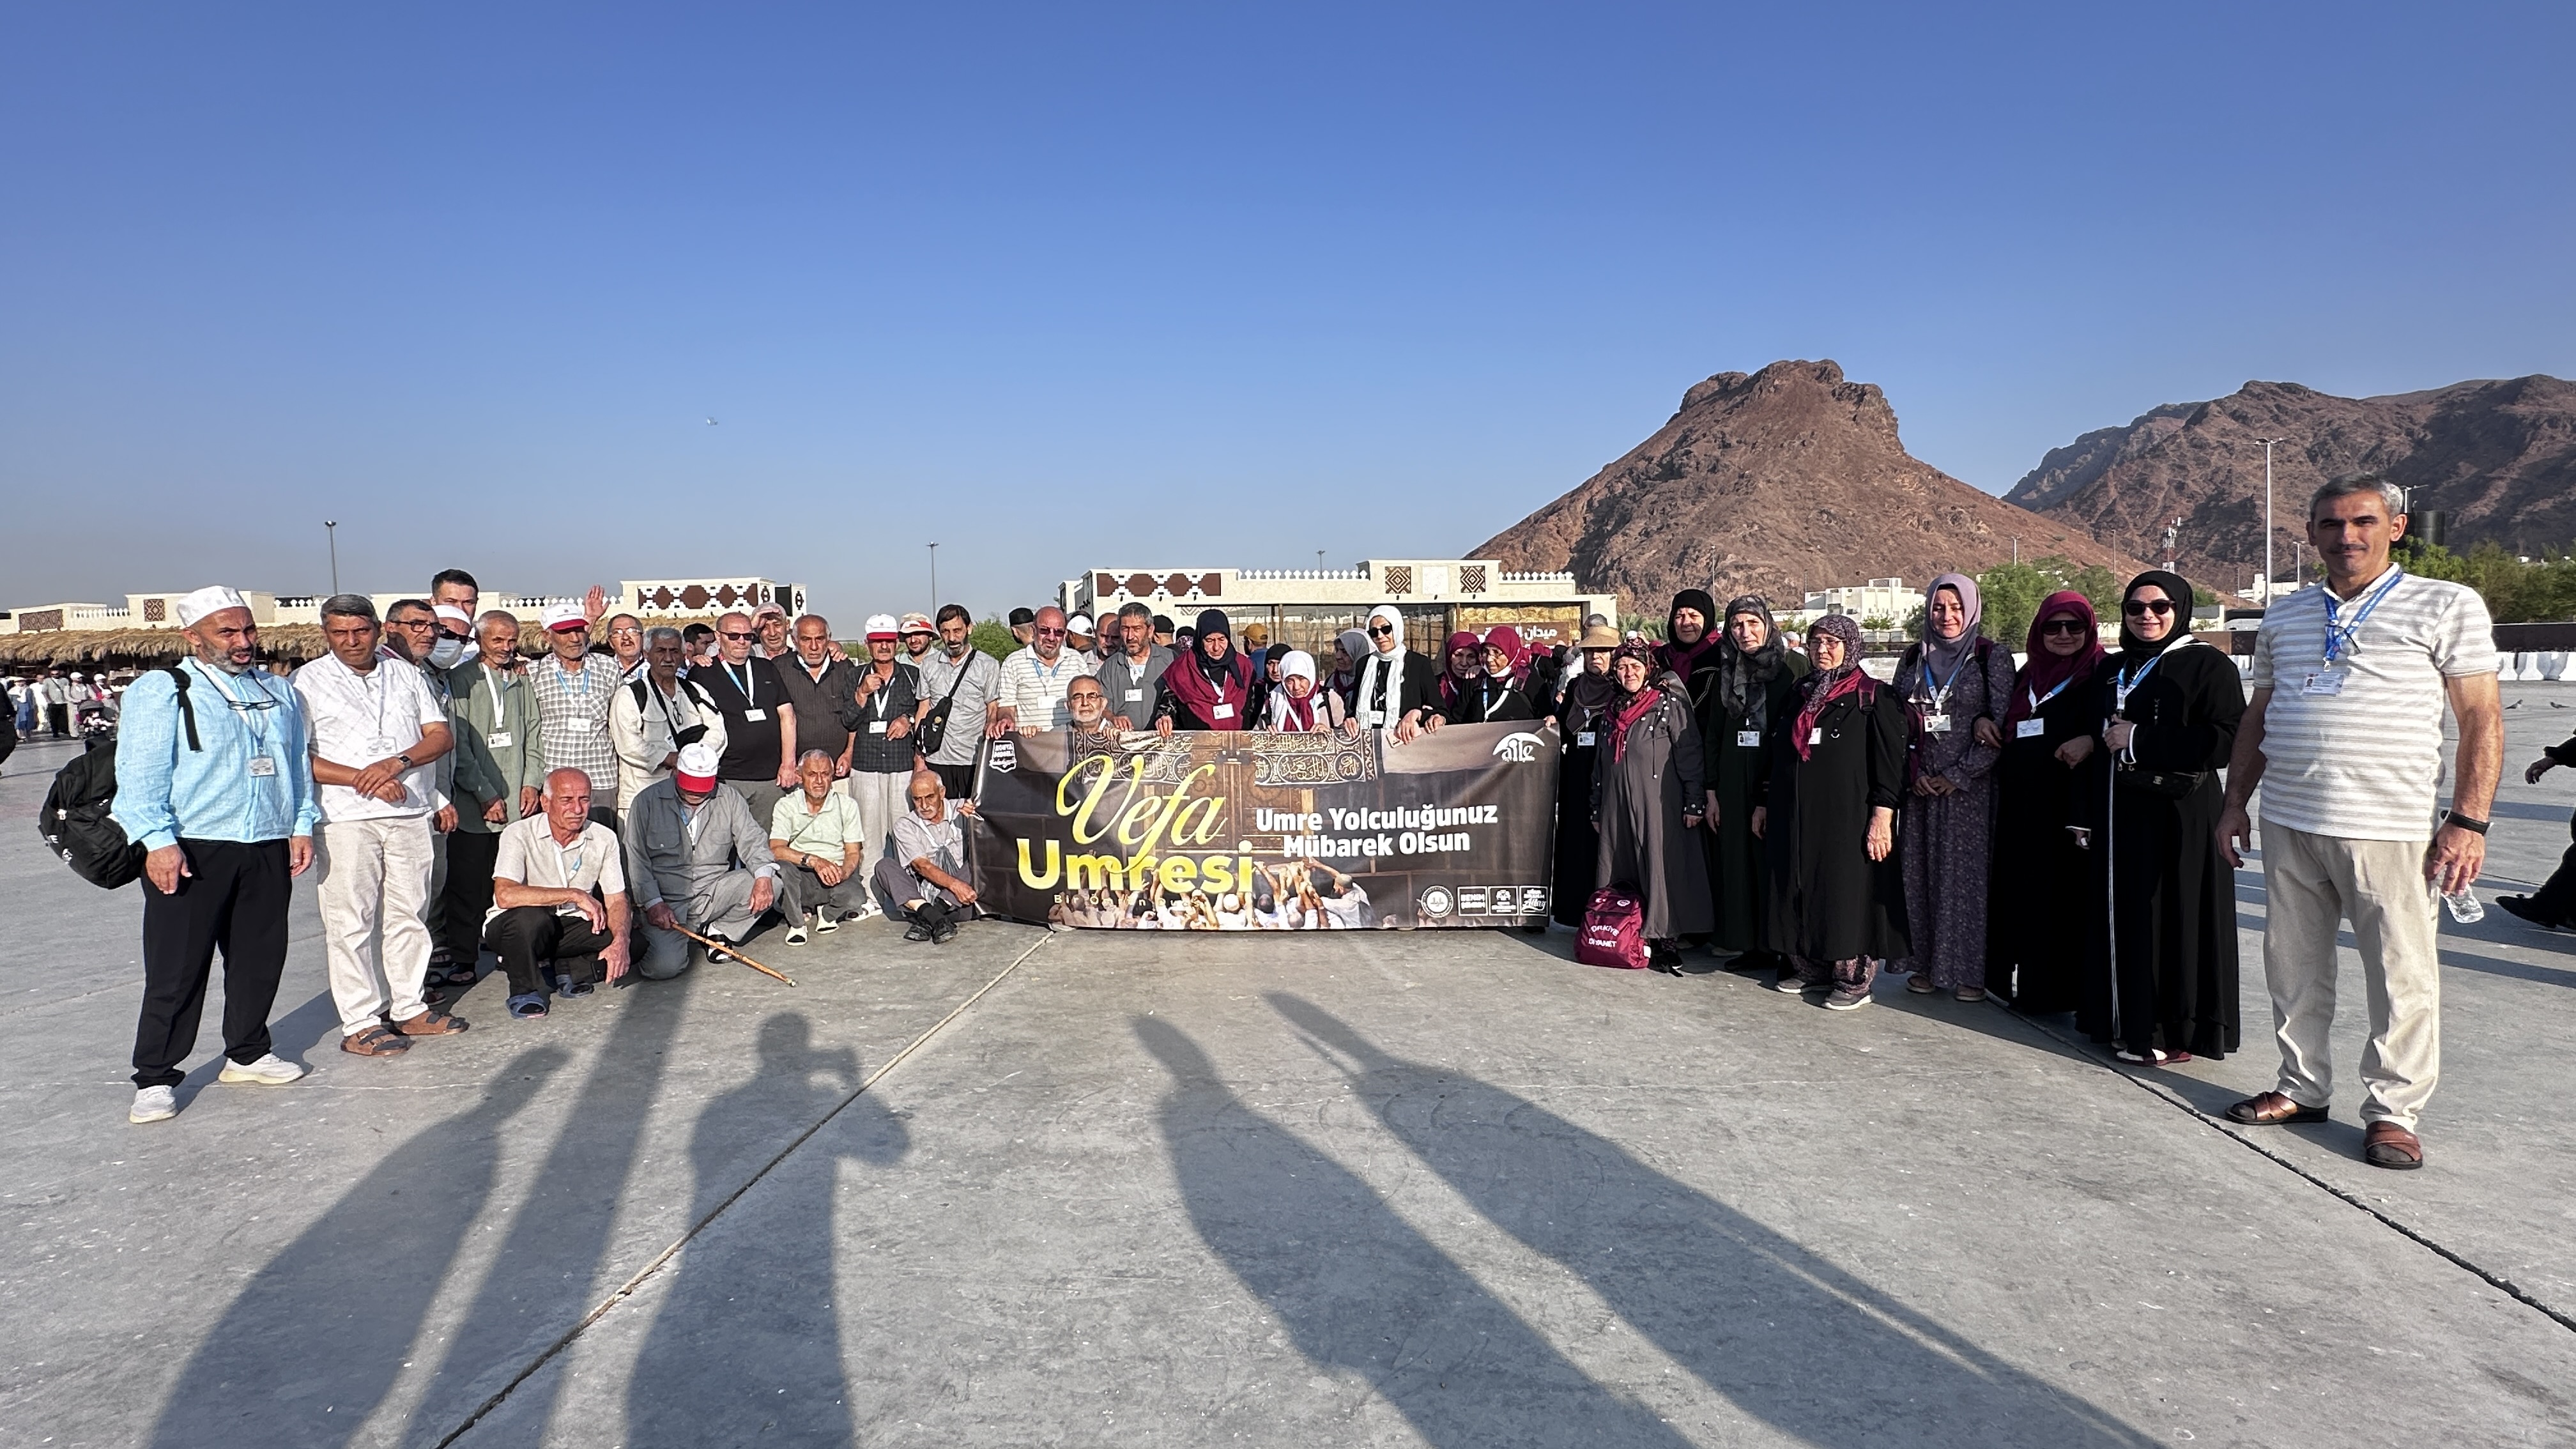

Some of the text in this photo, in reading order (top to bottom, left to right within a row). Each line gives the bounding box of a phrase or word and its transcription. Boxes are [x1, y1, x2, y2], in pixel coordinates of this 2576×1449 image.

[1524, 625, 1558, 641] ميدان
[1501, 739, 1535, 763] aile
[1056, 755, 1228, 874] Vefa
[1256, 804, 1498, 831] Umre Yolculuğunuz
[1283, 831, 1471, 857] Mübarek Olsun
[1016, 838, 1253, 893] Umresi
[1089, 894, 1147, 906] Ömn
